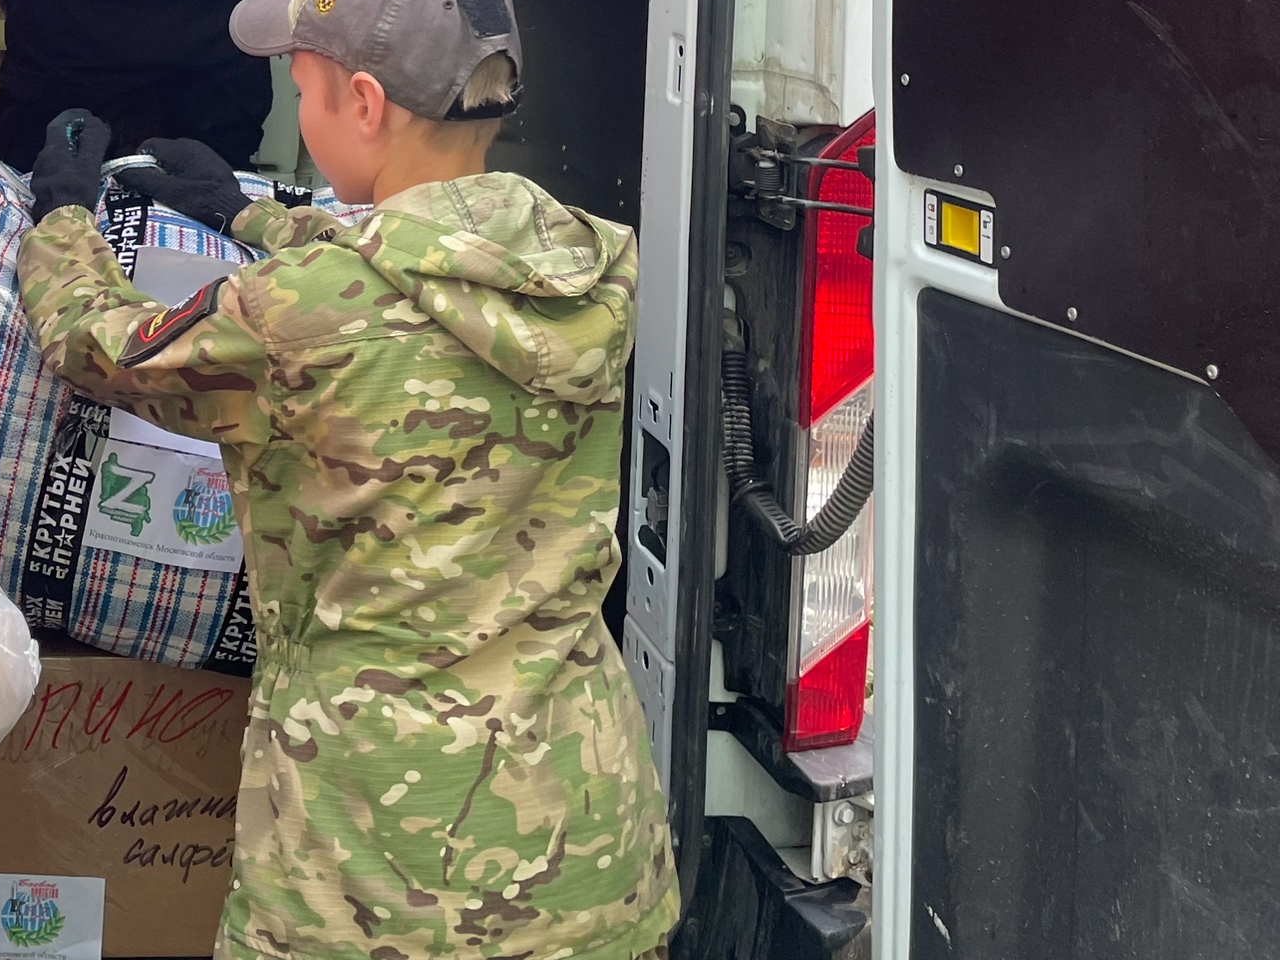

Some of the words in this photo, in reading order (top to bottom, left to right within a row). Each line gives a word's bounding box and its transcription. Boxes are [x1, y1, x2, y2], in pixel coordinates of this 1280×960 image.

[32, 452, 73, 560] КРУТЫХ
[89, 529, 154, 550] Краснознаменск
[156, 544, 204, 559] Московской
[204, 552, 236, 563] области
